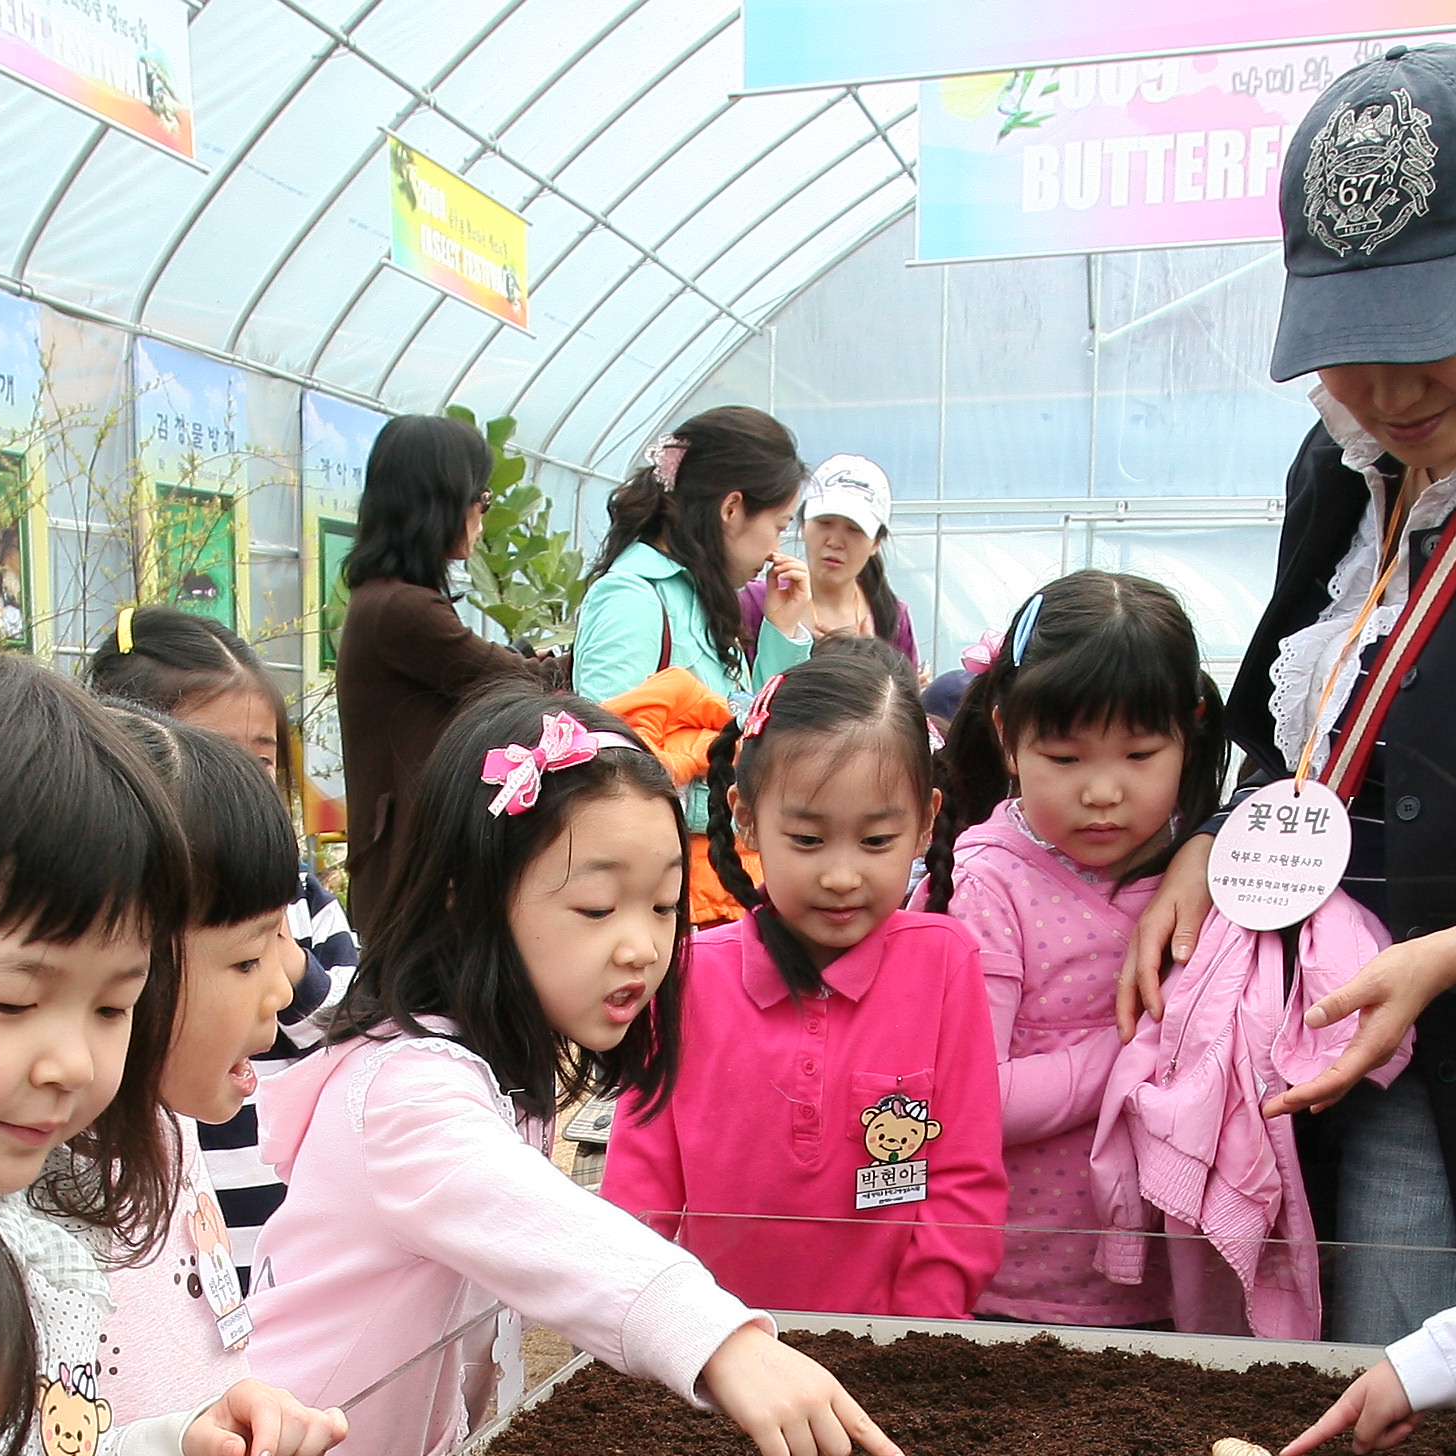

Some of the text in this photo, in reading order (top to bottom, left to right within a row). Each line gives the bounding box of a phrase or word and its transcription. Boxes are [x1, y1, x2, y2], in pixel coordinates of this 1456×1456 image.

[1232, 54, 1334, 97] 나비와
[1020, 123, 1294, 214] BUTTERF
[1338, 173, 1381, 206] 67
[1247, 802, 1331, 835] 꽃잎반
[1230, 849, 1324, 868] 학부모 자원봉사자
[861, 1164, 918, 1189] 박현아
